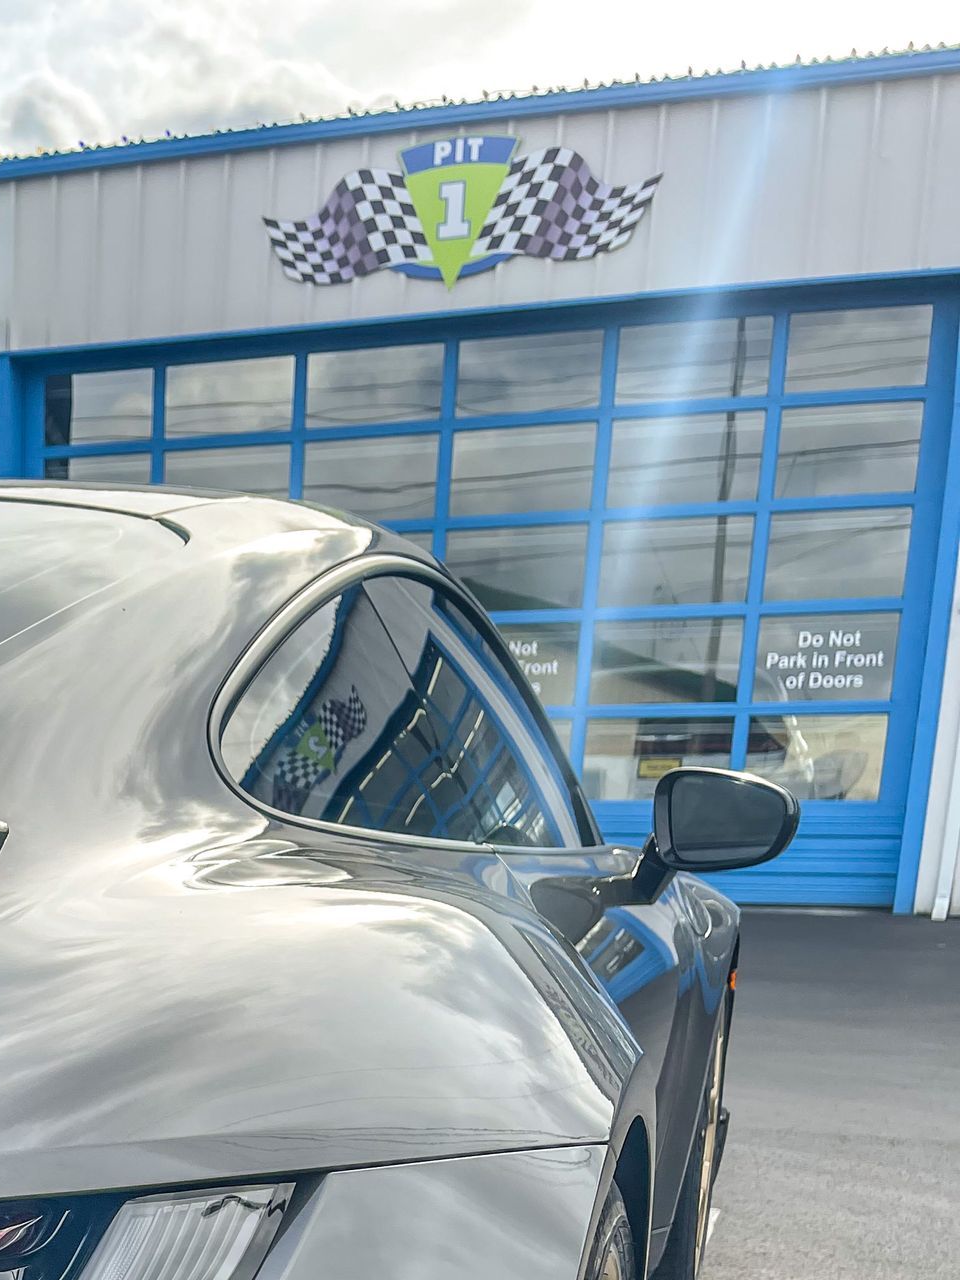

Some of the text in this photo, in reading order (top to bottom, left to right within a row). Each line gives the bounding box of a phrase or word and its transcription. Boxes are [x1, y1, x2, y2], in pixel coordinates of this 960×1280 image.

[433, 137, 484, 166] PIT
[438, 181, 470, 239] 1
[508, 640, 538, 656] Not
[798, 630, 861, 648] Do Not
[766, 650, 884, 670] Park in Front
[785, 671, 864, 689] of Doors
